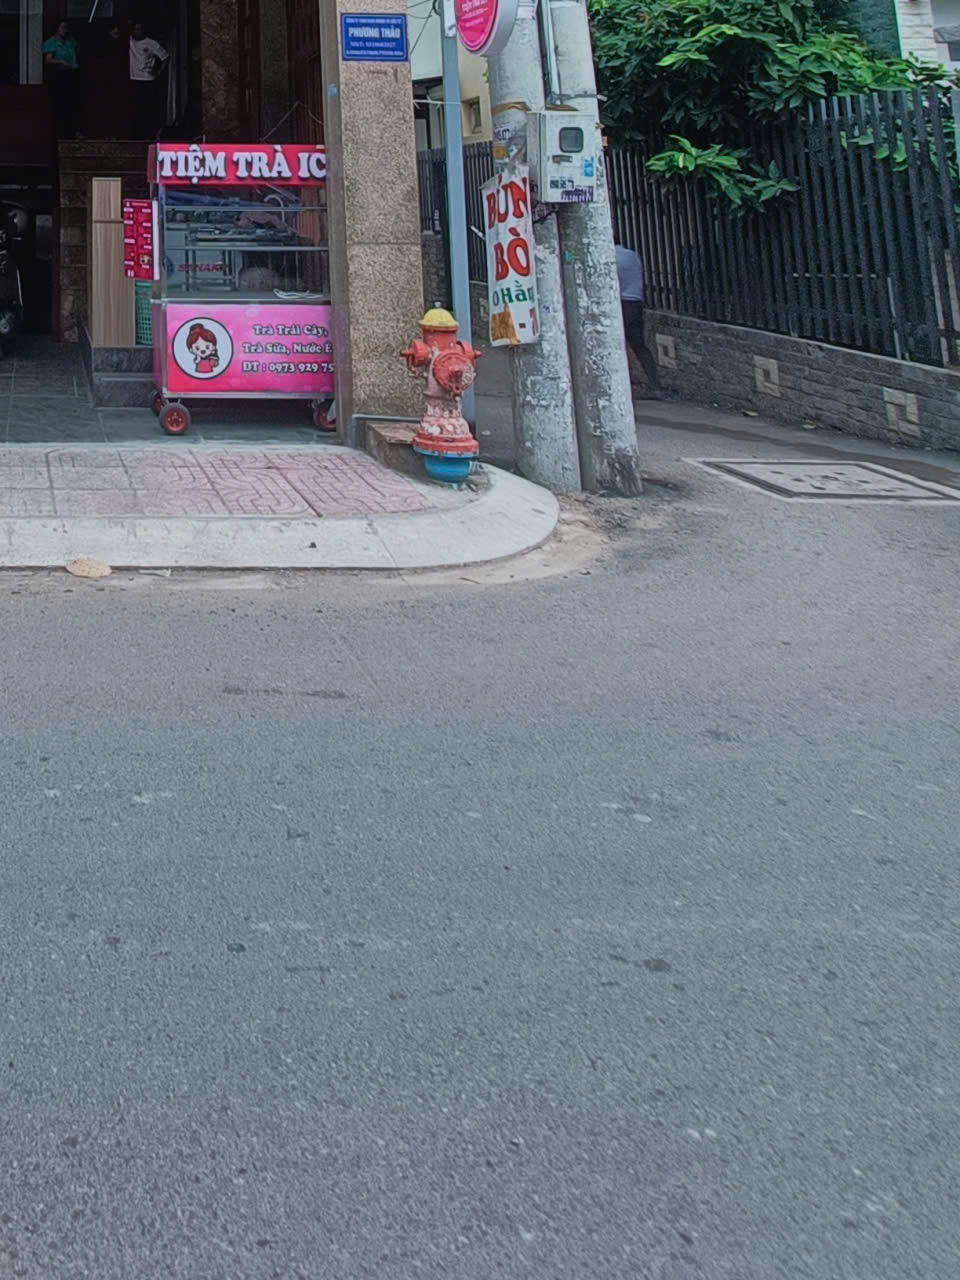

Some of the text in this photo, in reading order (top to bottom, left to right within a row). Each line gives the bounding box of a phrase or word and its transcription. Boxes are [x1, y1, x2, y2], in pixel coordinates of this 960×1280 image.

[158, 144, 327, 184] TIỆM TRÀ IC
[486, 174, 529, 229] BÚN
[494, 227, 531, 281] BÒ
[253, 324, 328, 337] Trà Trái Cây,
[242, 343, 263, 353] Trà
[265, 342, 290, 355] Sữa,
[293, 342, 321, 353] Nước
[269, 363, 296, 373] 0973
[298, 363, 319, 373] 929
[321, 363, 335, 373] 75
